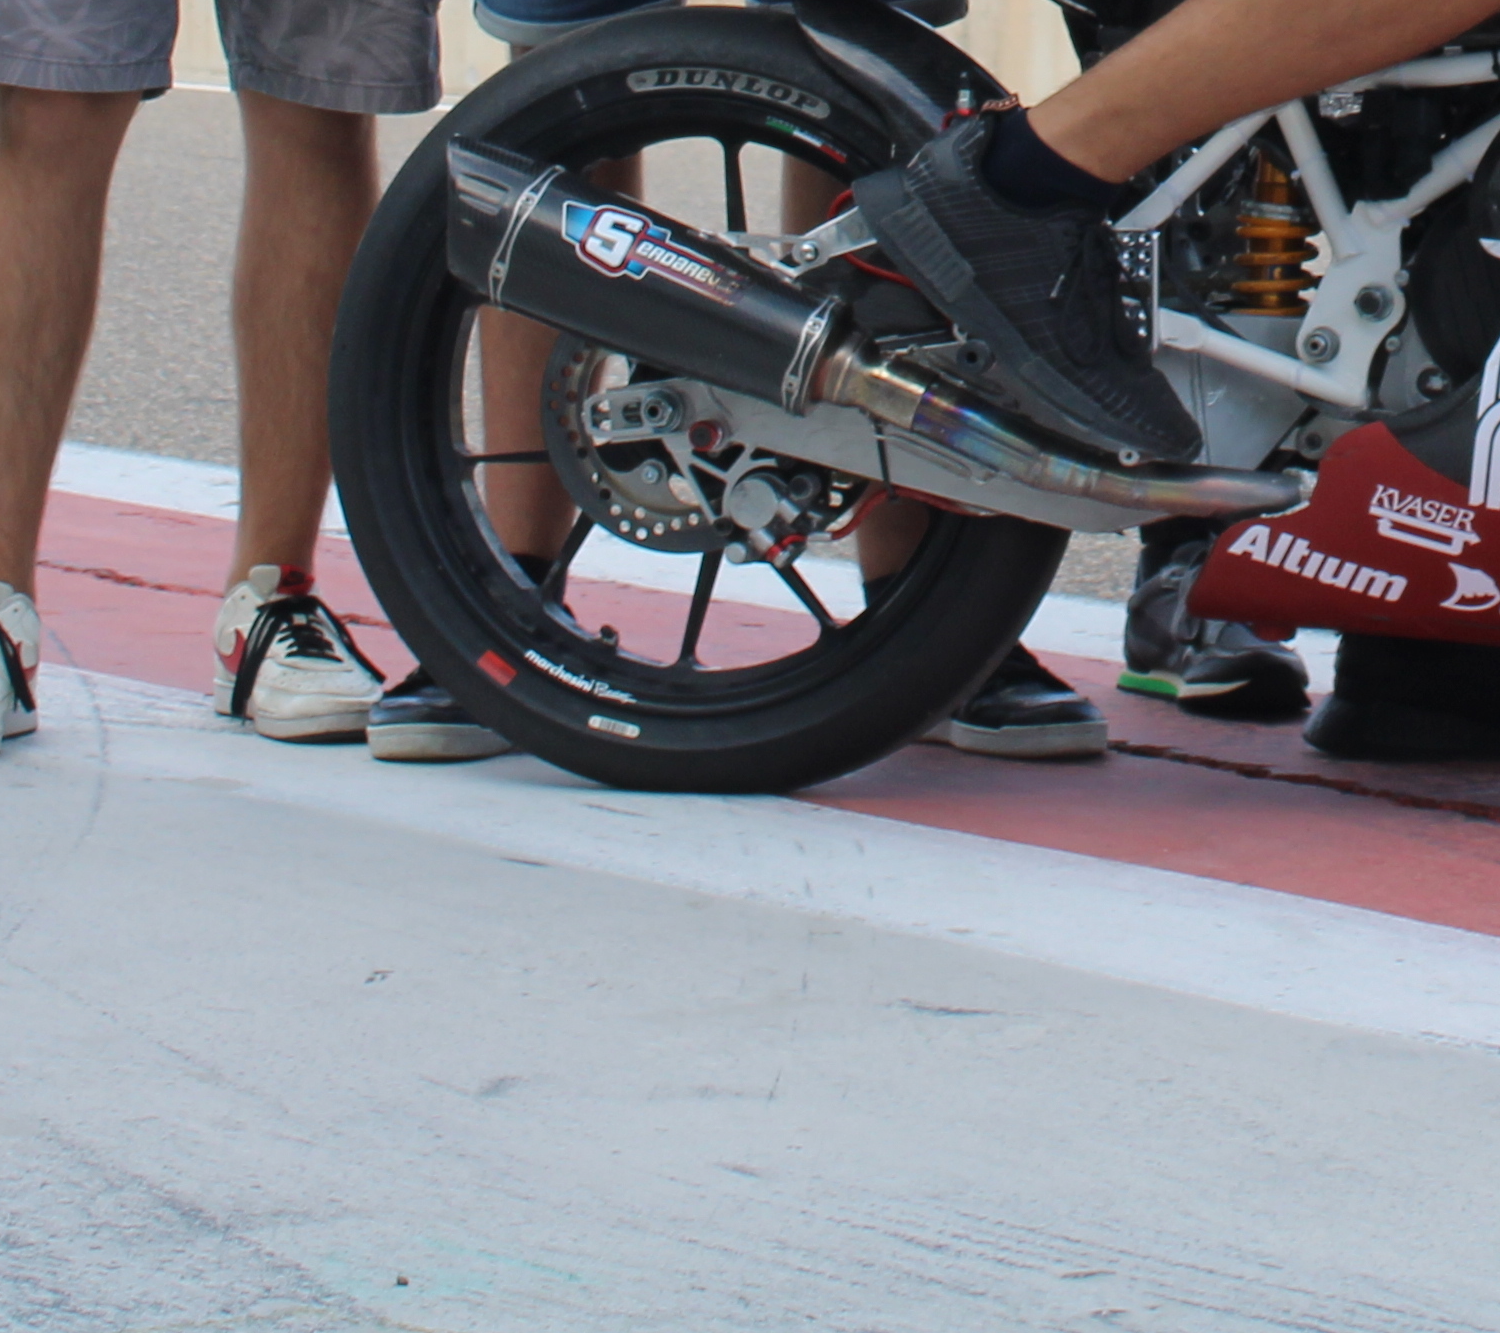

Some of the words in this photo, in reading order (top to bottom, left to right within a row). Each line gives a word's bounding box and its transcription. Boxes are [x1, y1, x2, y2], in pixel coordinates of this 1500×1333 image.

[652, 68, 822, 112] DUNLOP
[1370, 483, 1478, 532] KVASER
[1227, 523, 1409, 603] Altium
